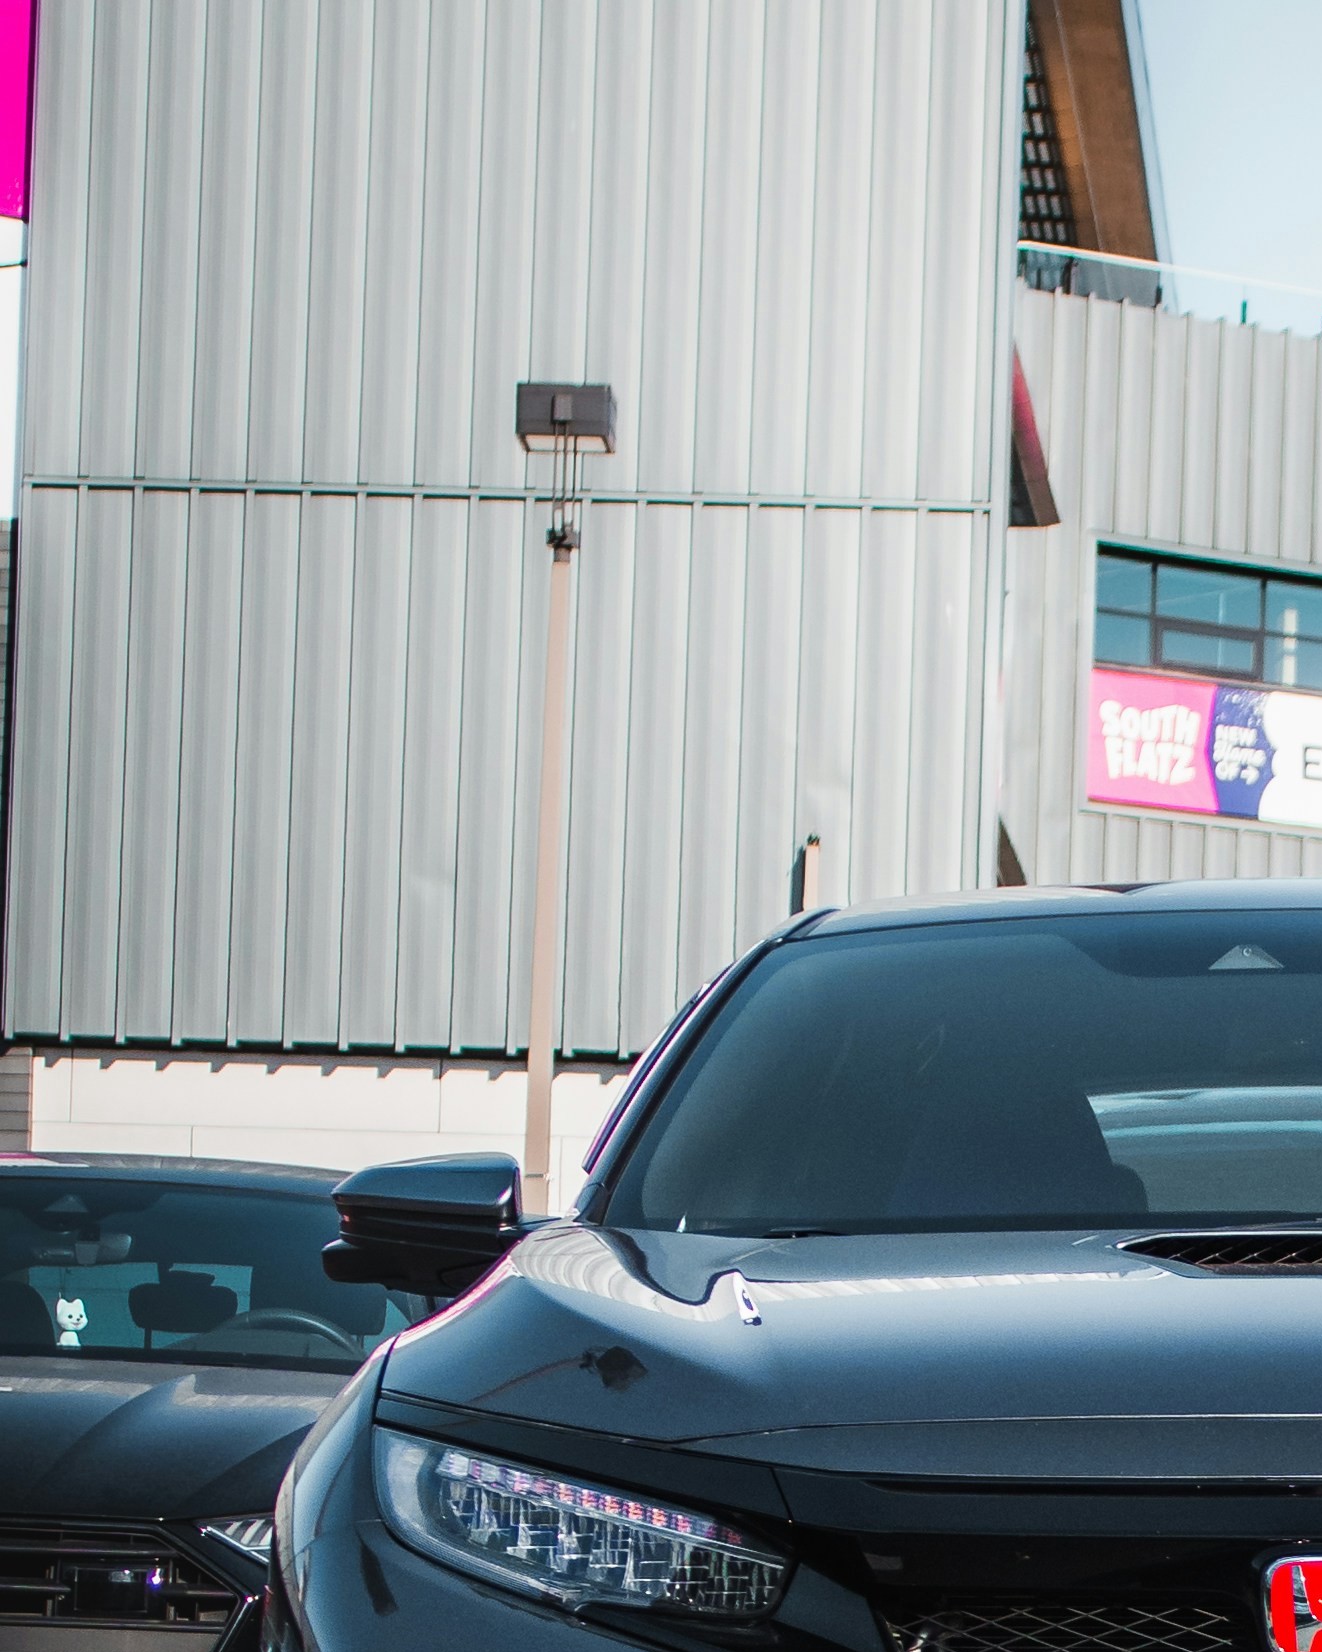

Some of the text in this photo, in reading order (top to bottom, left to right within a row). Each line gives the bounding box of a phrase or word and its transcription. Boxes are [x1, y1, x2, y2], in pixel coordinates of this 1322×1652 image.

[1099, 699, 1201, 747] SOUTH
[1215, 724, 1258, 747] NEW
[1104, 735, 1197, 786] FLATZ
